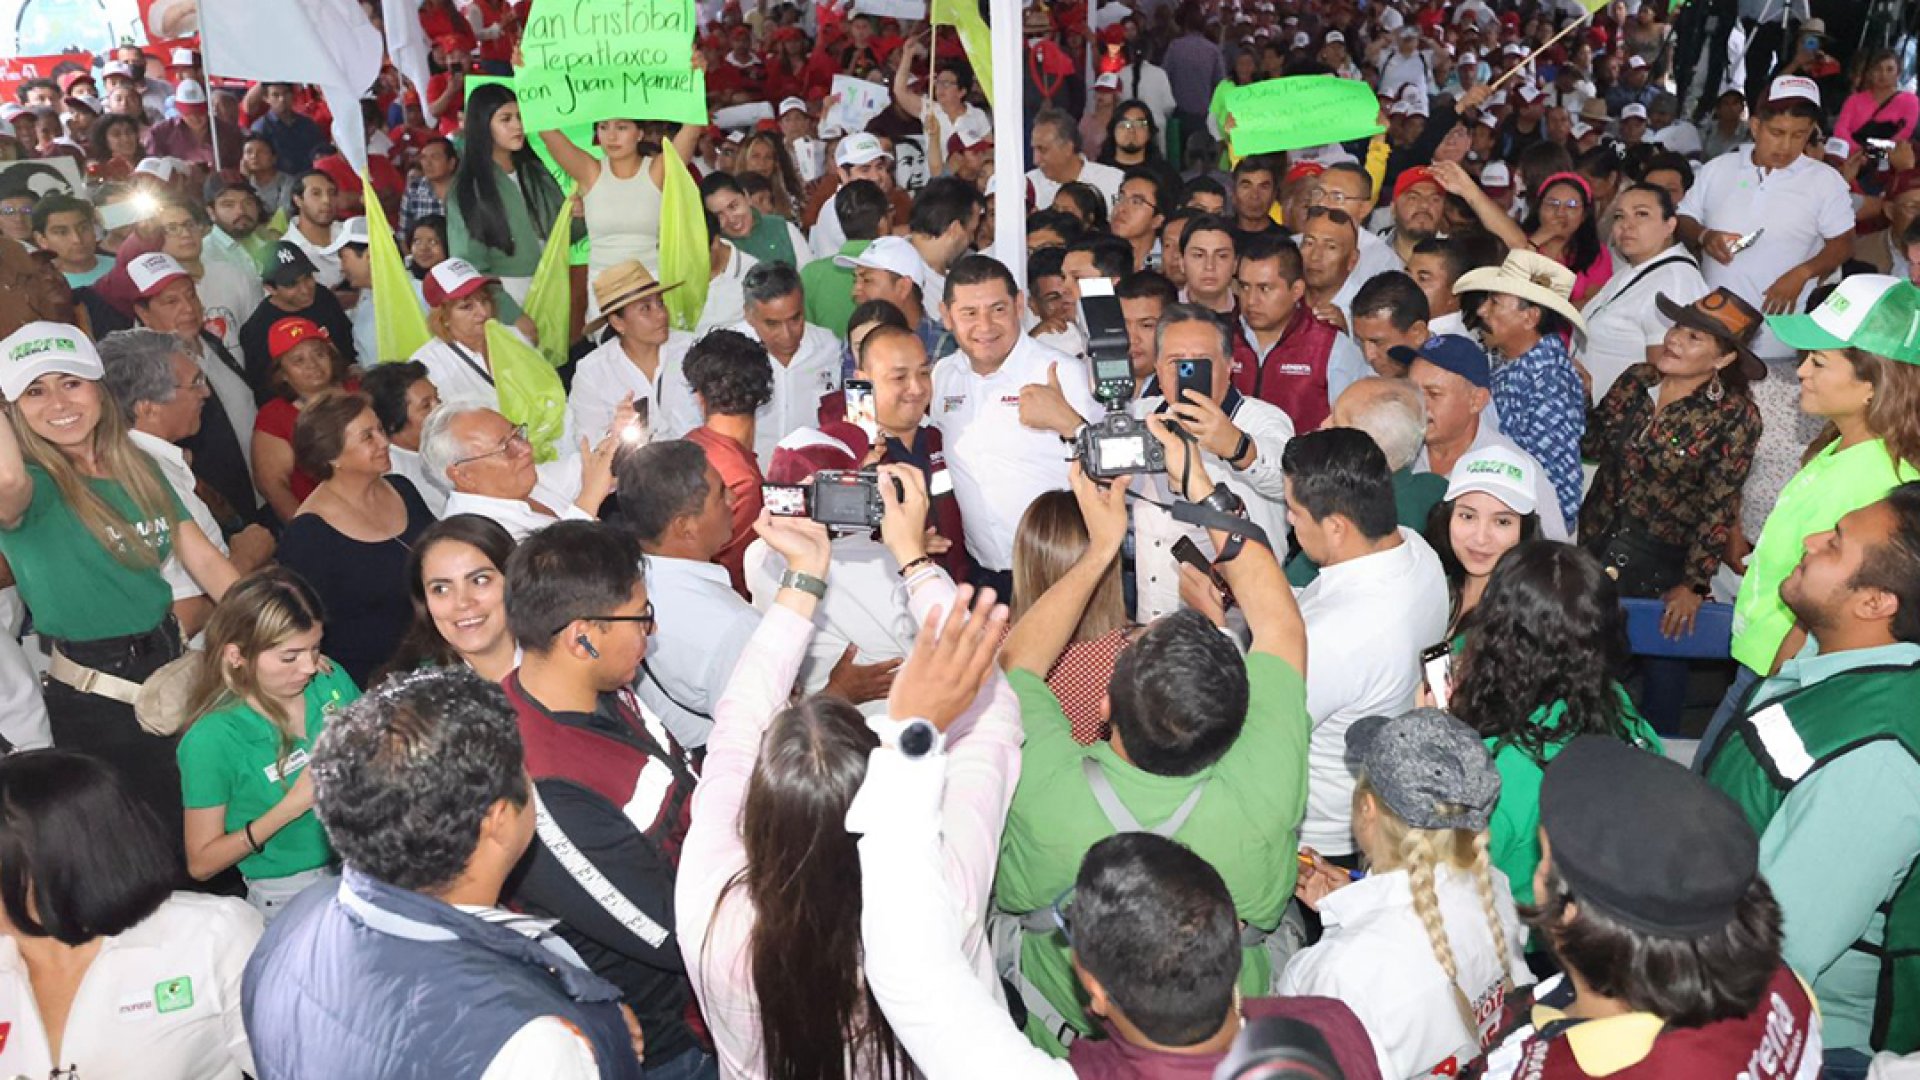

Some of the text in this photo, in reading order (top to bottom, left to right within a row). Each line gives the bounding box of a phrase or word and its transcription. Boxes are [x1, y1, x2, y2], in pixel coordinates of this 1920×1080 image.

[528, 13, 566, 39] an
[529, 40, 668, 72] Tepatlaxco
[518, 70, 694, 115] con Juan Manuel
